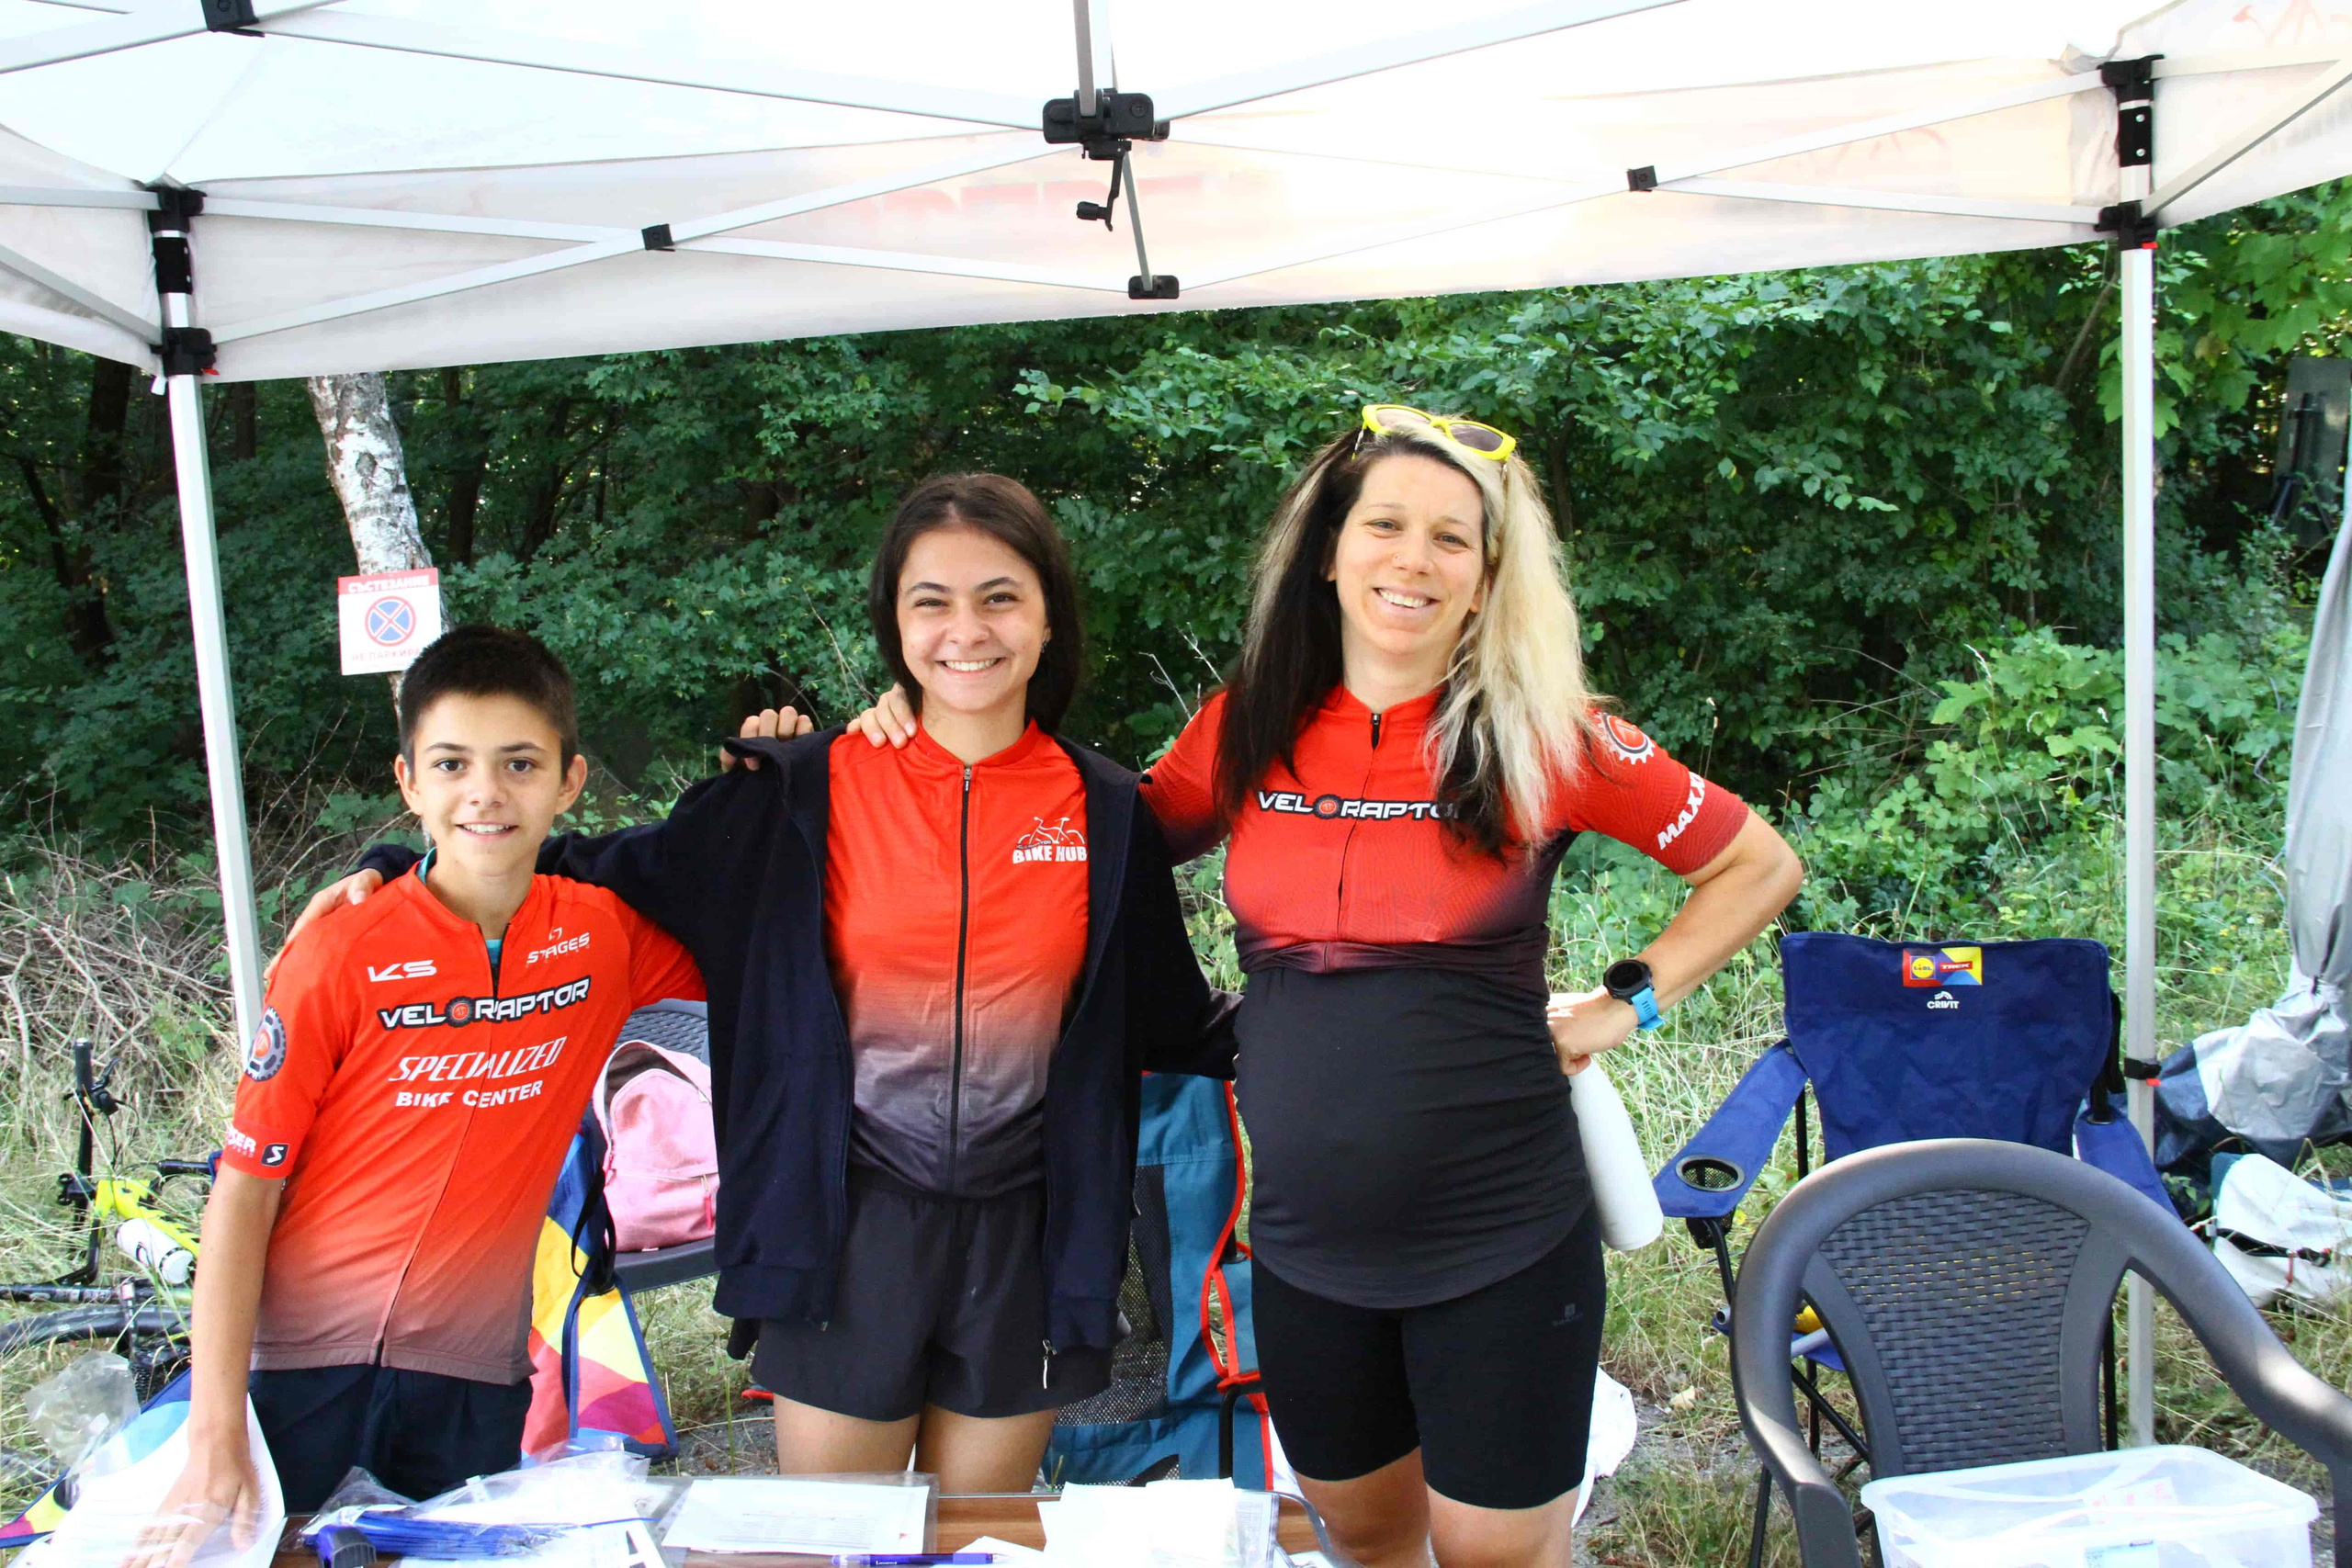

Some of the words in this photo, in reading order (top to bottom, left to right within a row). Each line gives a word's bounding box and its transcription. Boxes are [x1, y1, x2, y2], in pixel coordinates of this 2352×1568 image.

[369, 649, 421, 660] ПАРКИРА
[1012, 845, 1052, 863] BIKE
[1056, 846, 1087, 862] HUB
[526, 931, 590, 964] STAGES
[367, 959, 437, 982] KS
[1927, 1000, 1960, 1010] CRIVIT
[388, 1036, 568, 1081] SPECIALIZED
[395, 1091, 455, 1108] BIKE
[462, 1080, 543, 1108] CENTER
